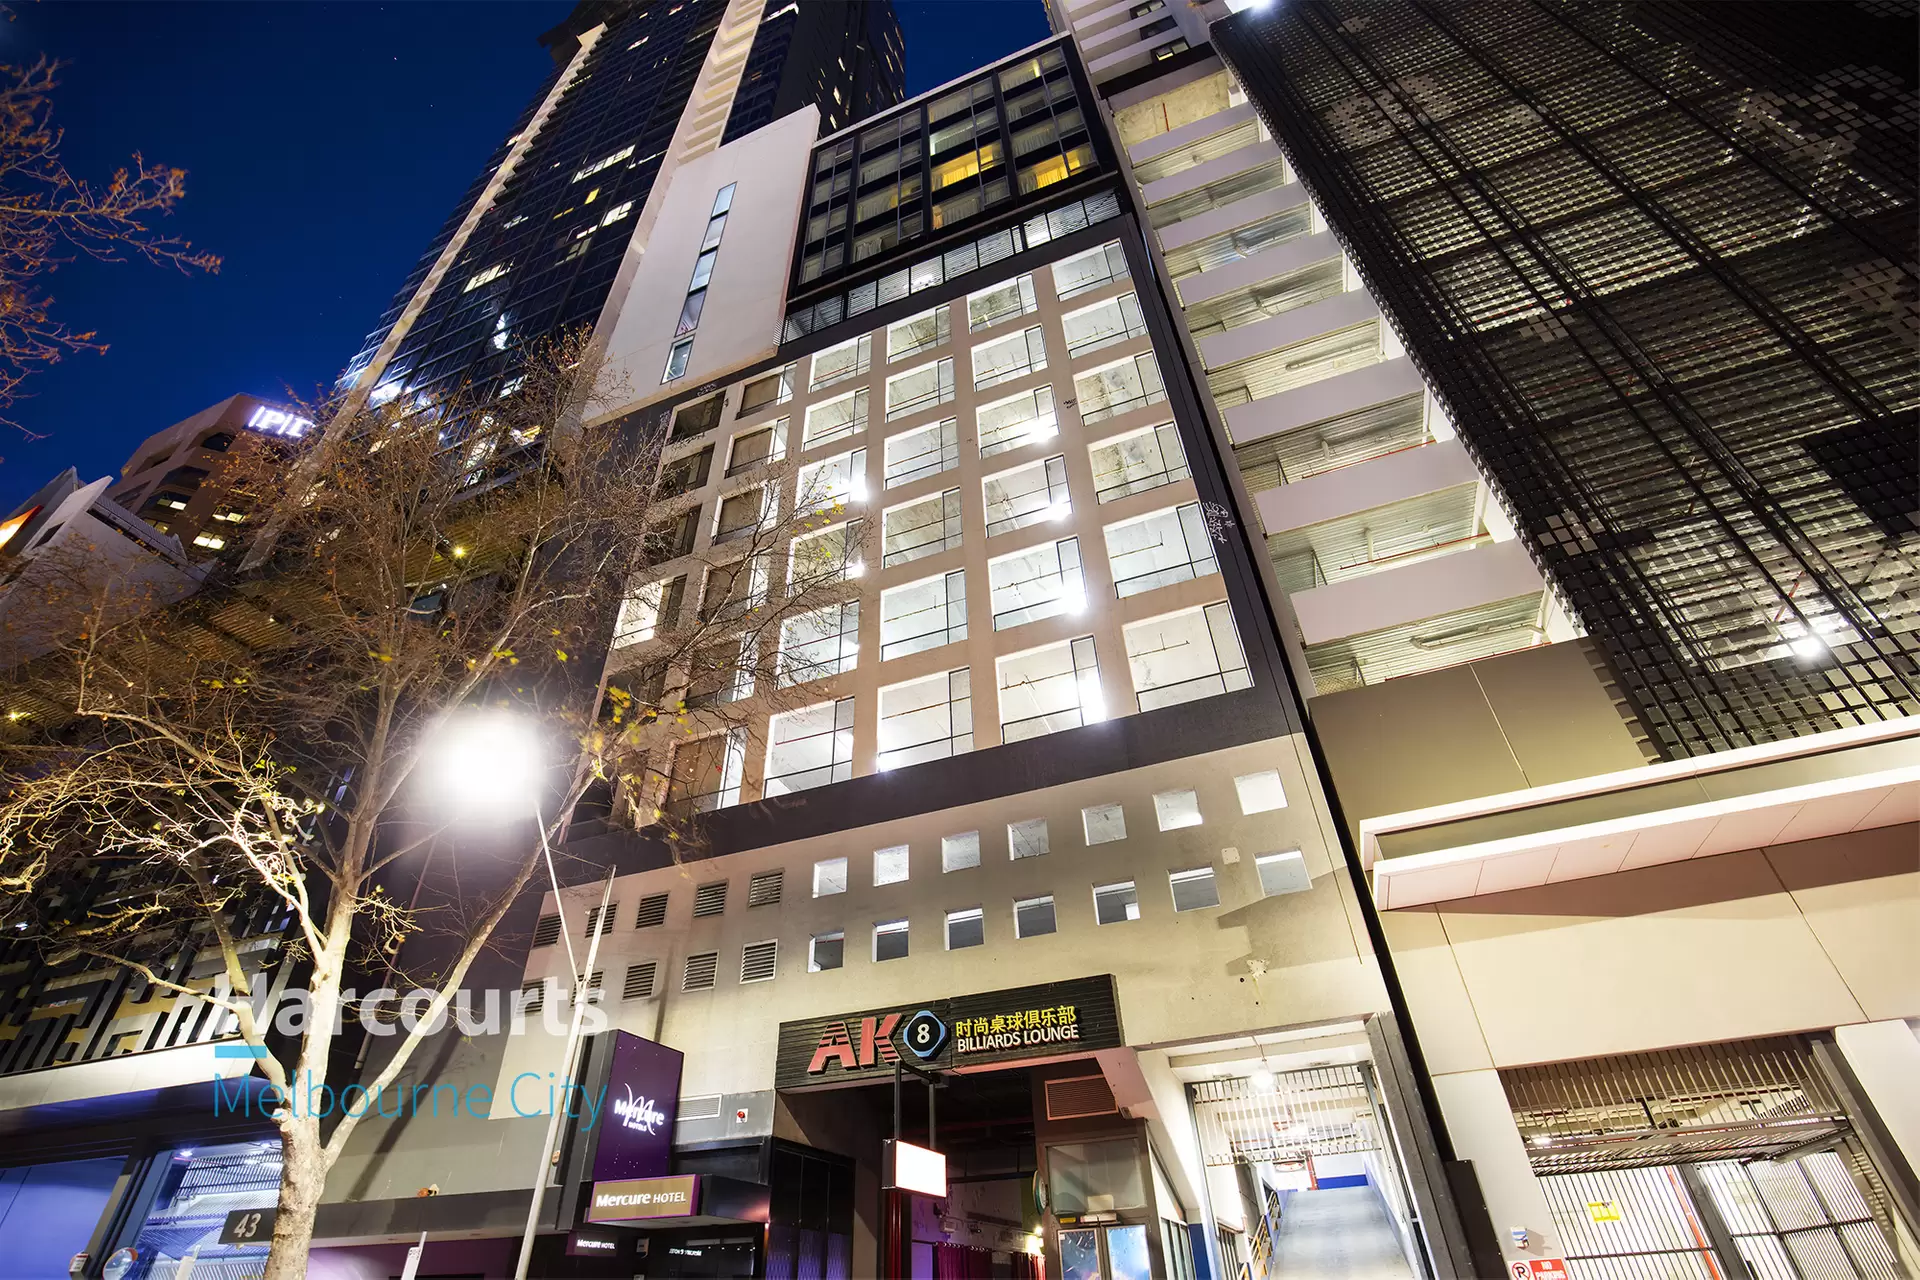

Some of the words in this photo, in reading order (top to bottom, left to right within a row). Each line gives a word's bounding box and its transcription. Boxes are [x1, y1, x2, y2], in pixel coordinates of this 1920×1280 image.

[956, 1005, 1077, 1038] 时尚桌球俱乐部
[807, 1013, 901, 1073] AK
[916, 1023, 930, 1044] 8
[958, 1031, 1020, 1053] BILLIARDS
[1024, 1024, 1080, 1045] LOUNGE
[596, 1193, 651, 1208] Mercure
[653, 1191, 687, 1204] HOTEL
[233, 1213, 262, 1238] 43
